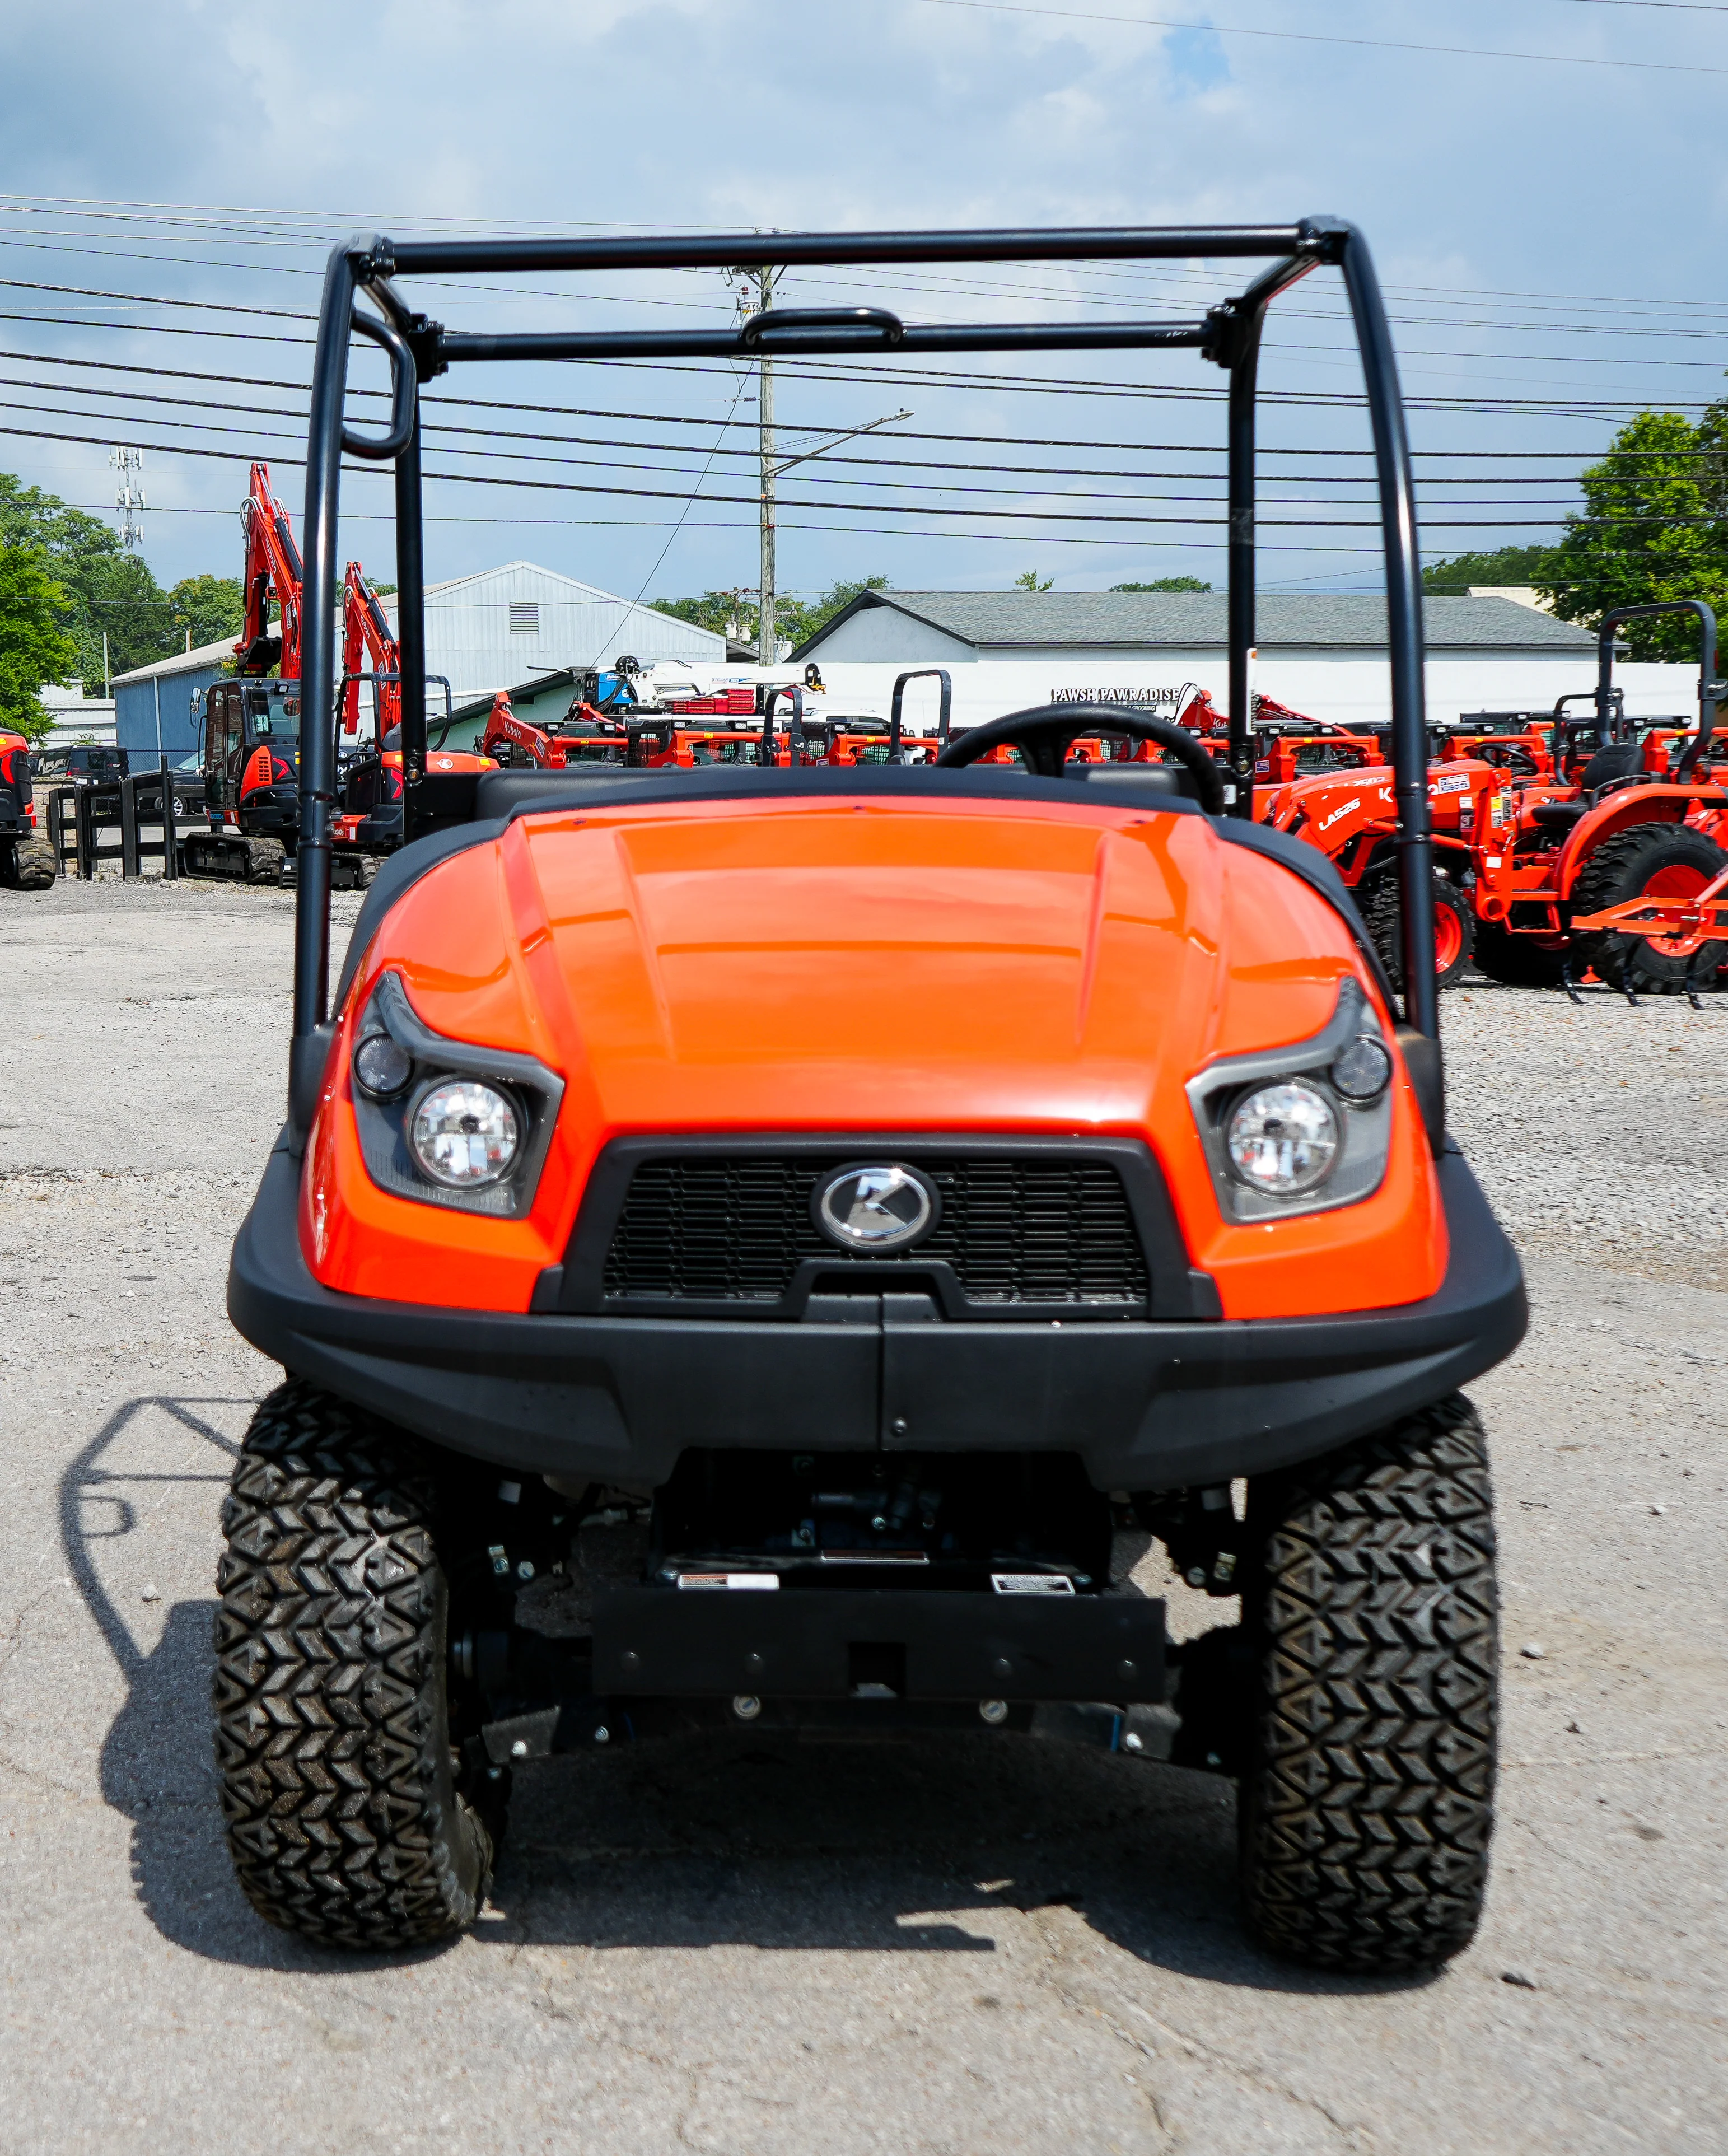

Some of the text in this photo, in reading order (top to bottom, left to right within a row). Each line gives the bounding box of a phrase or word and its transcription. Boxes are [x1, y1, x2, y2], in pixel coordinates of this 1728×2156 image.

[1052, 688, 1180, 701] PAWSH PAWRADISE
[504, 720, 521, 739] Kubota
[1318, 797, 1361, 831] LA526
